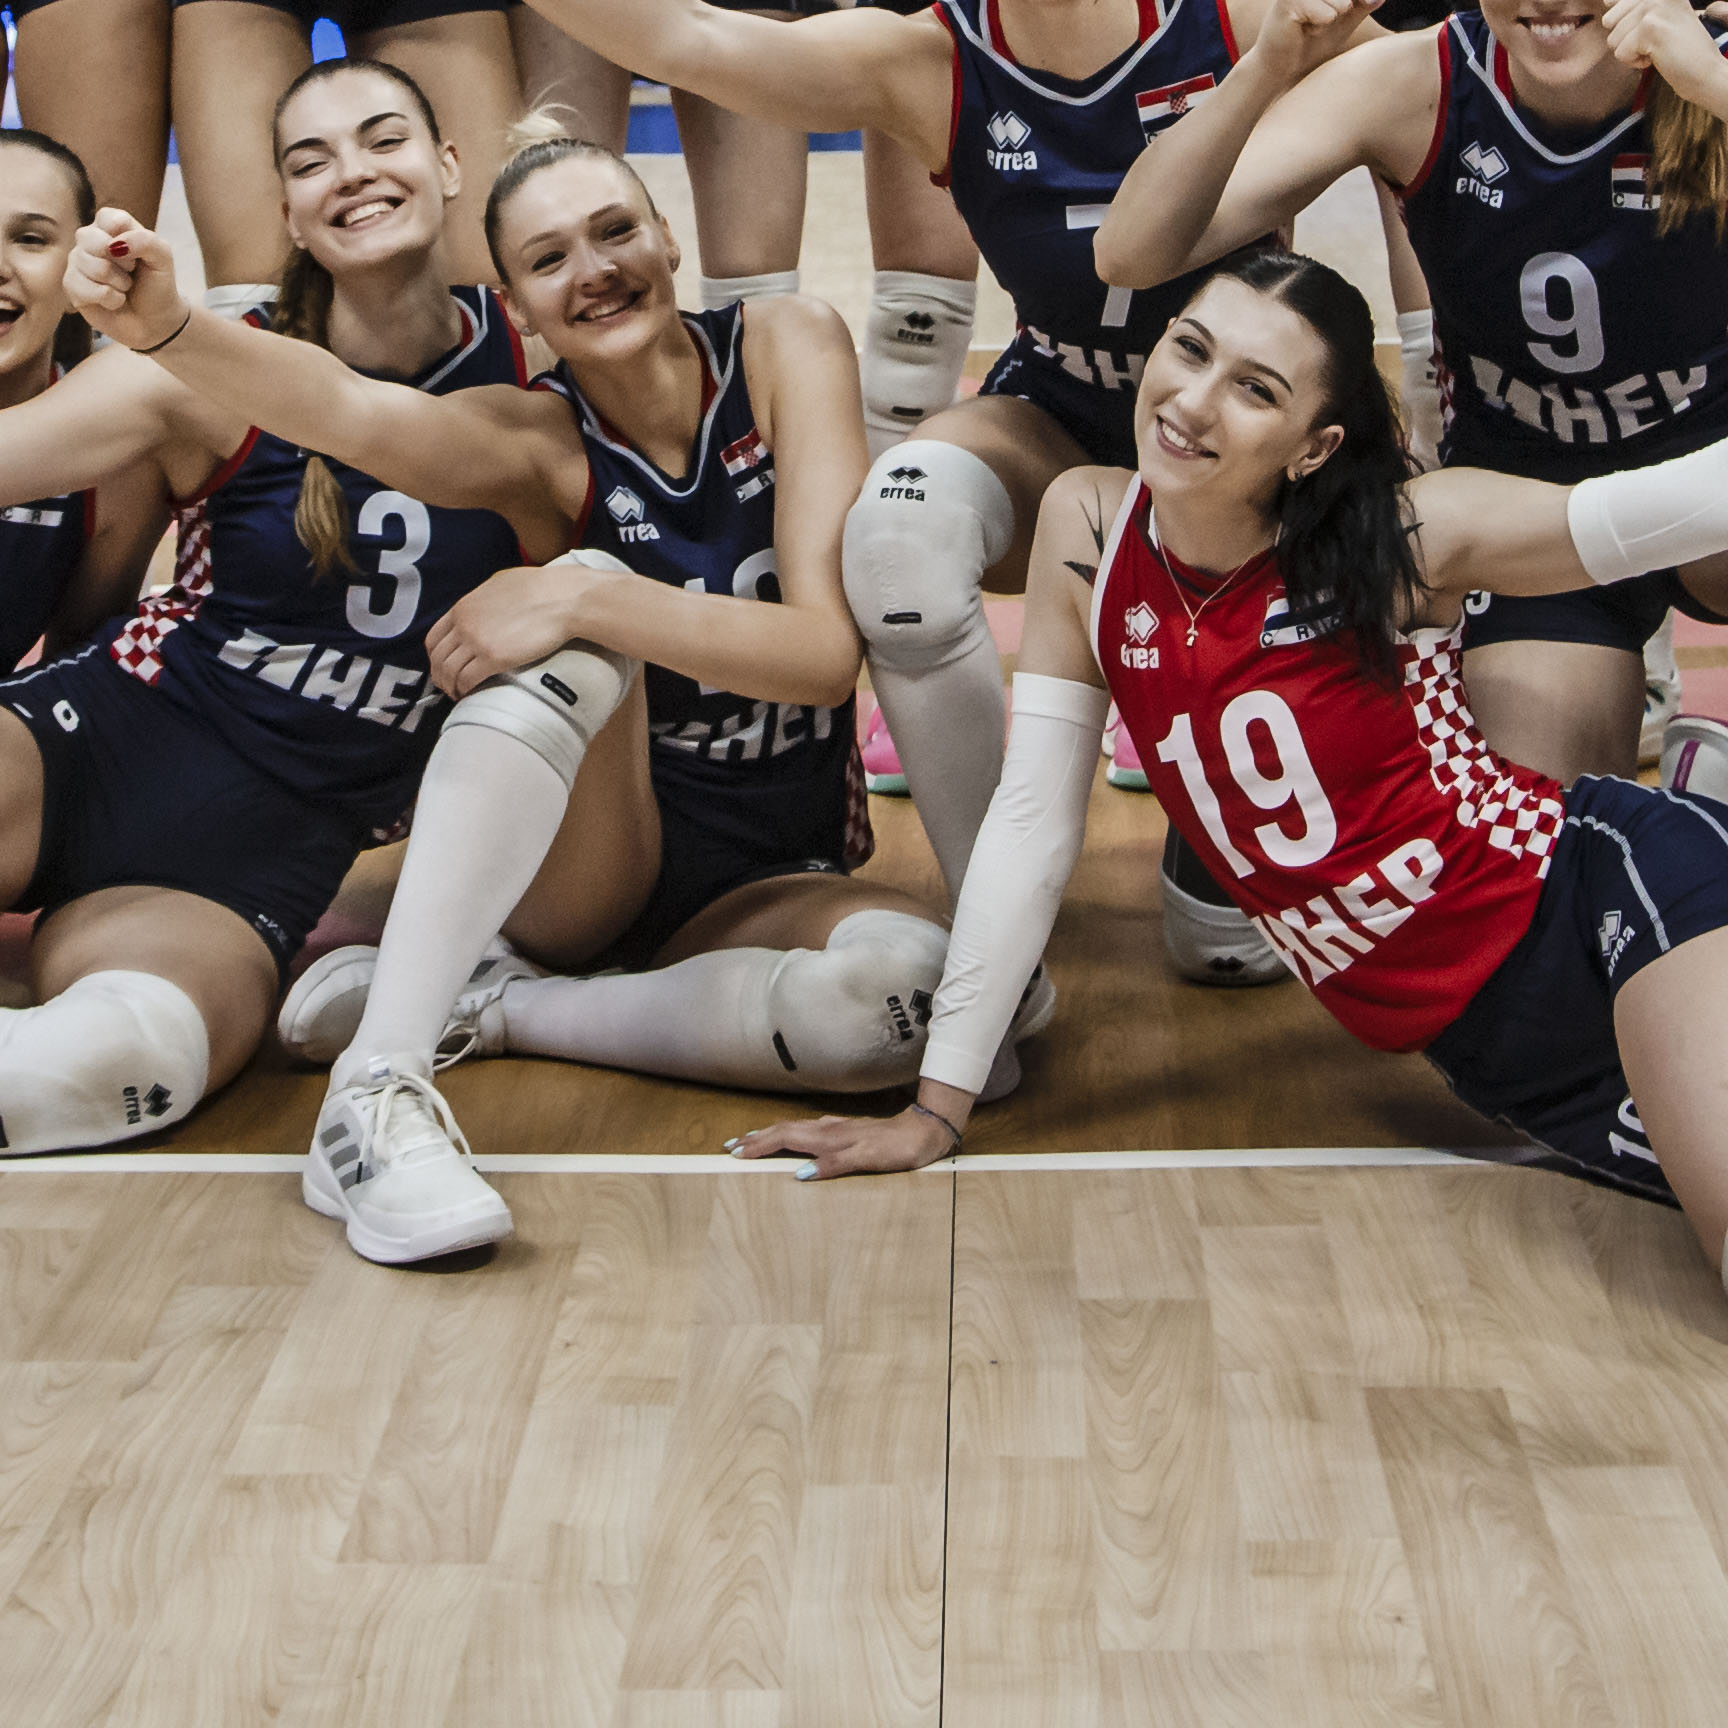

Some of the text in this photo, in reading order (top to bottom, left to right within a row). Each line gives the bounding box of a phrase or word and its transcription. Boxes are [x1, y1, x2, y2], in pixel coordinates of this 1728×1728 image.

[986, 149, 1038, 171] errea
[1519, 251, 1604, 373] 9
[880, 487, 926, 503] errea
[346, 490, 431, 639] 3
[1156, 689, 1336, 878] 19
